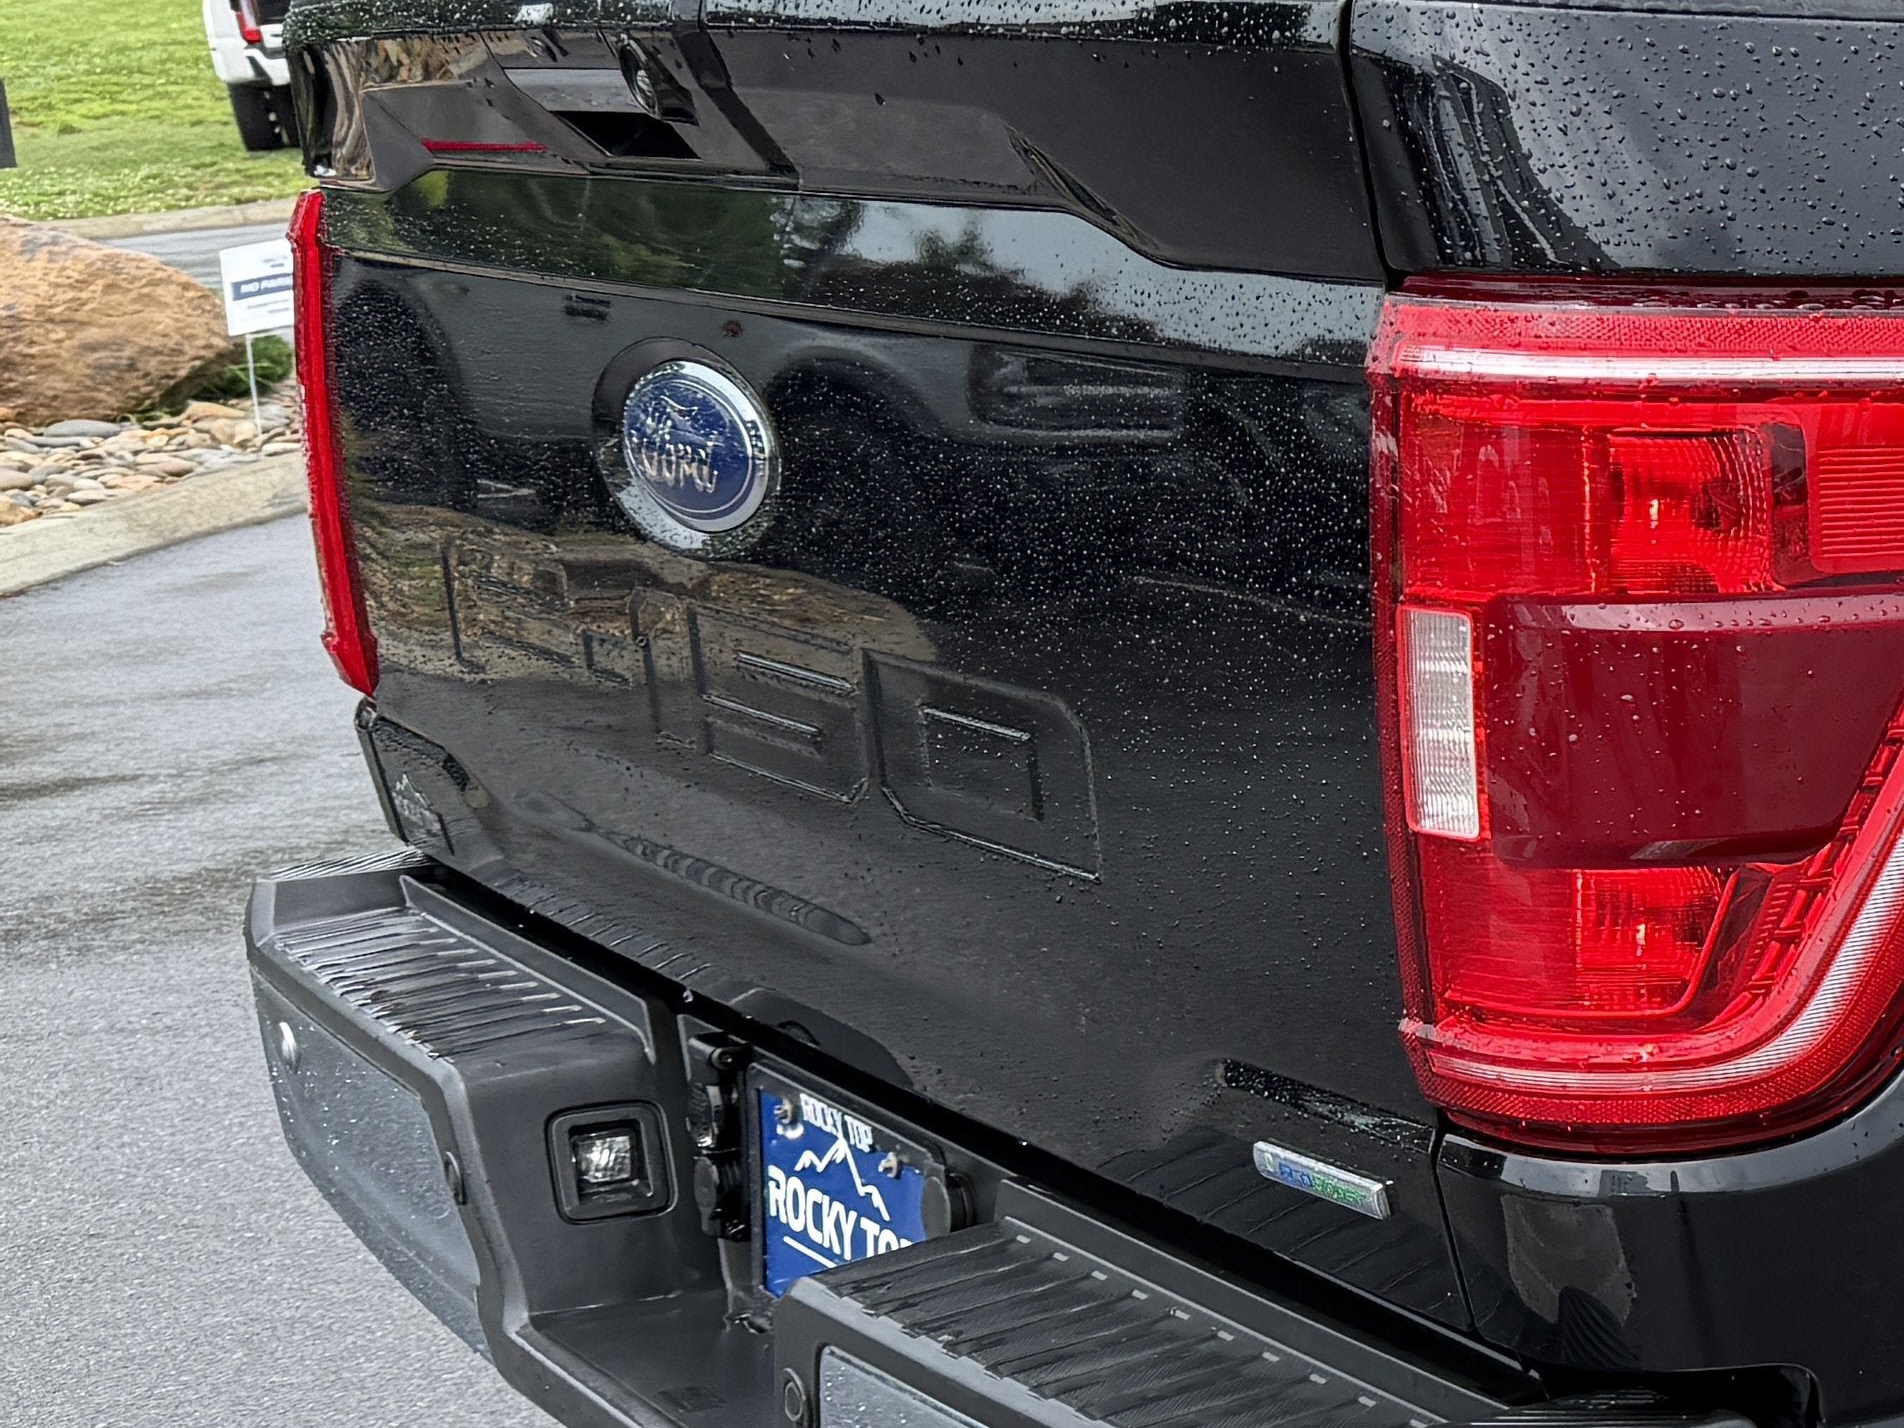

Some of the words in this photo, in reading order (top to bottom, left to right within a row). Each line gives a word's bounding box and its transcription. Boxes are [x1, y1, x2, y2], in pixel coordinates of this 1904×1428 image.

[799, 1092, 844, 1139] ROCKY
[844, 1114, 874, 1153] TOP
[767, 1164, 858, 1261] ROCKY
[859, 1215, 914, 1258] TO
